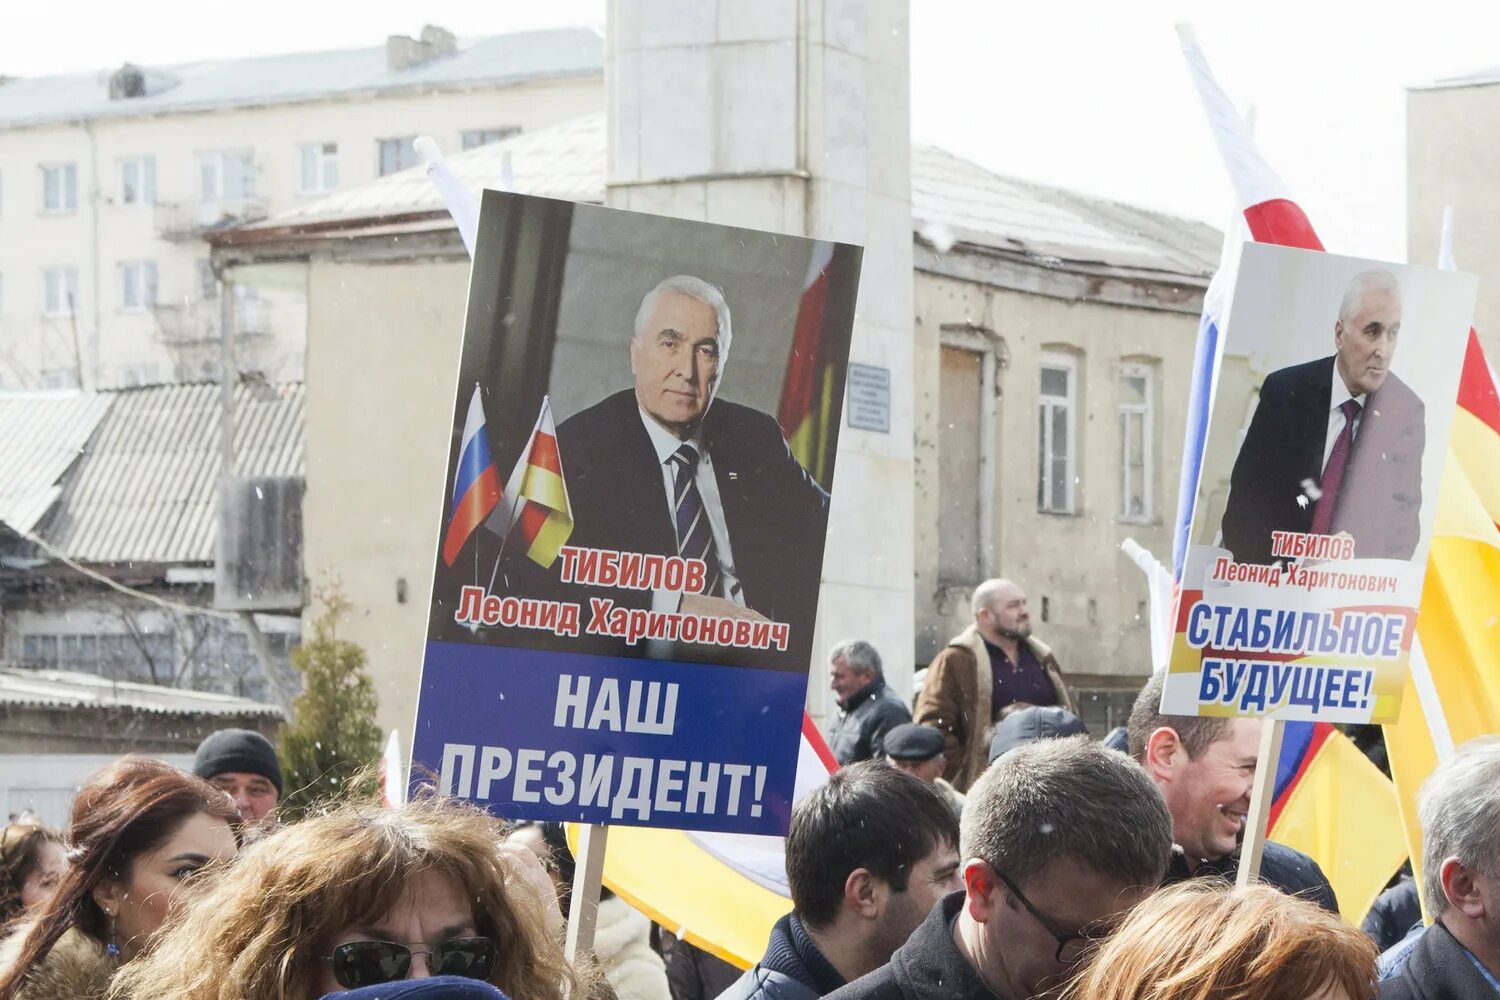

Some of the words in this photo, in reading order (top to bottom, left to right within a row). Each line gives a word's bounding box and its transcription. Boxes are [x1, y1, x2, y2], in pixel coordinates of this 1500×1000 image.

[560, 547, 706, 593] ТИБИЛОВ
[1272, 531, 1354, 560] ТИБИЛОВ
[1212, 557, 1281, 588] Леонид
[1286, 564, 1398, 594] Харитонович
[455, 587, 580, 636] Леонид
[586, 600, 791, 650] Харитонович
[1189, 604, 1403, 656] СТАБИЛЬНОЕ
[553, 674, 679, 736] НАШ
[1199, 661, 1373, 713] БУДУЩЕЕ!
[440, 743, 767, 821] ПРЕЗИДЕНТ!
